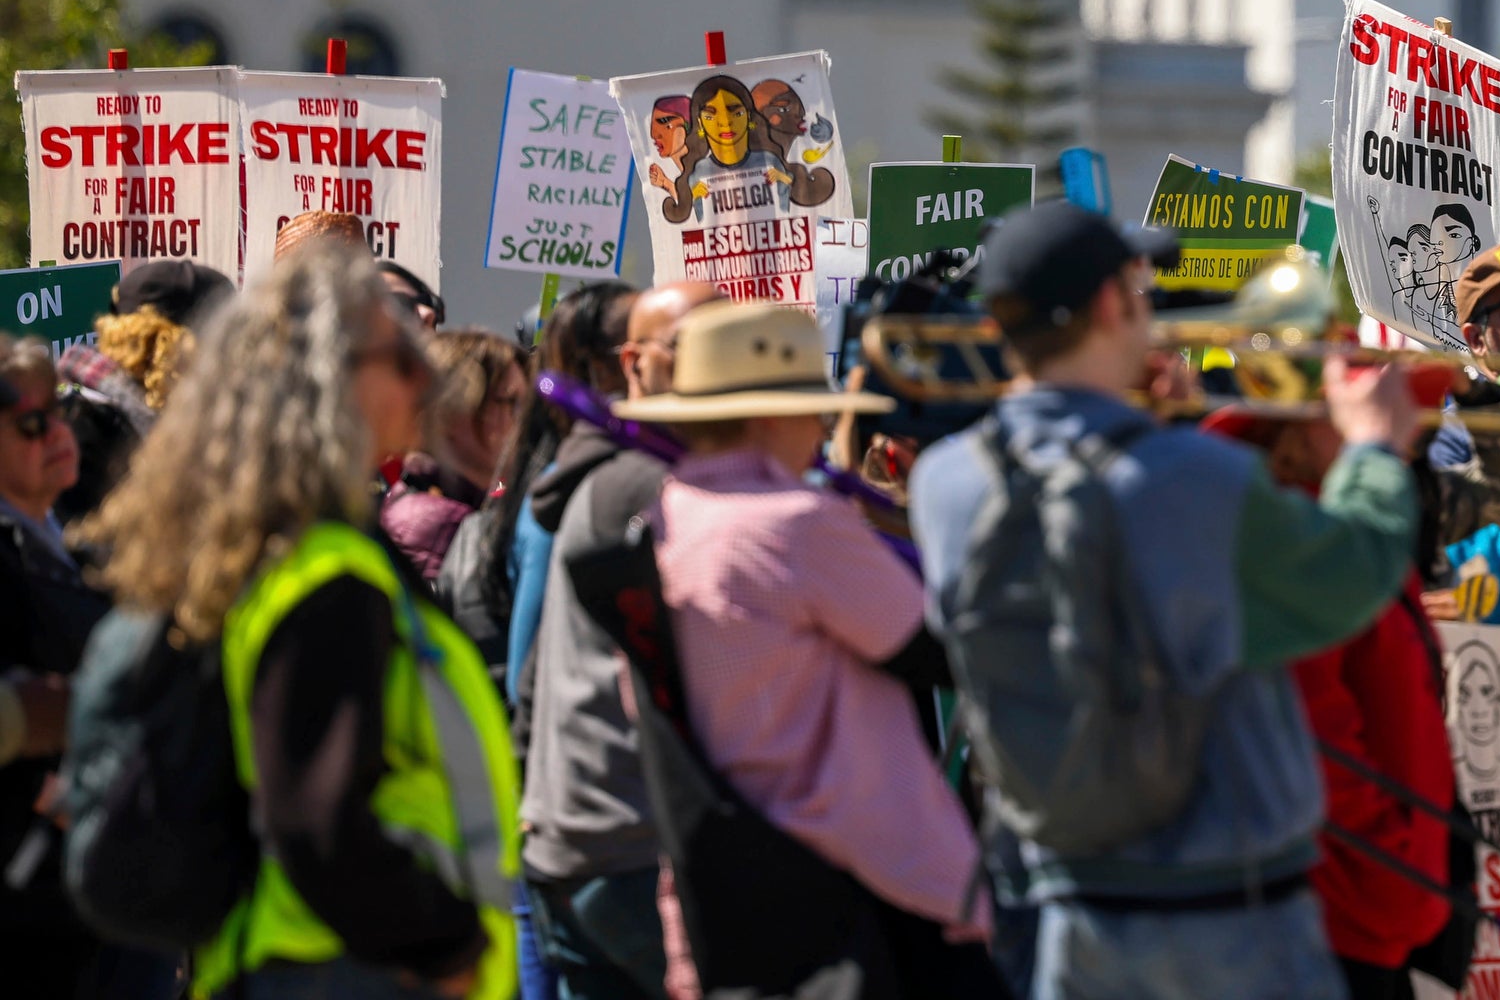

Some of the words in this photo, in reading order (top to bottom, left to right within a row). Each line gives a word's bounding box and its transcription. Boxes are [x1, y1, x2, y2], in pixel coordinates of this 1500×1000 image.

[97, 95, 140, 116] READY
[145, 95, 162, 114] TO
[298, 97, 339, 117] READY
[343, 99, 359, 118] TO
[1388, 86, 1407, 114] FOR
[528, 98, 619, 139] SAFE
[1391, 111, 1399, 133] A
[1414, 95, 1472, 152] FAIR
[41, 122, 229, 168] STRIKE
[251, 120, 427, 171] STRIKE
[519, 147, 617, 174] STABLE
[294, 174, 315, 193] FOR
[1362, 130, 1493, 207] CONTRACT
[85, 178, 108, 195] FOR
[115, 176, 176, 215] FAIR
[302, 193, 310, 211] A
[321, 176, 373, 215] FAIR
[527, 183, 625, 207] RACIALLY
[710, 183, 774, 213] HUELGA
[93, 197, 101, 215] A
[915, 188, 985, 226] FAIR
[1152, 193, 1235, 228] ESTAMOS
[1244, 194, 1289, 230] CON
[63, 218, 200, 260] CONTRACT
[526, 217, 593, 239] JUST
[683, 241, 705, 260] PARA
[703, 218, 807, 258] ESCUELAS
[499, 235, 616, 269] SCHOOLS
[686, 248, 811, 281] COMMUNITARIAS
[1218, 257, 1232, 278] DE
[790, 274, 802, 301] Y
[16, 285, 63, 325] ON
